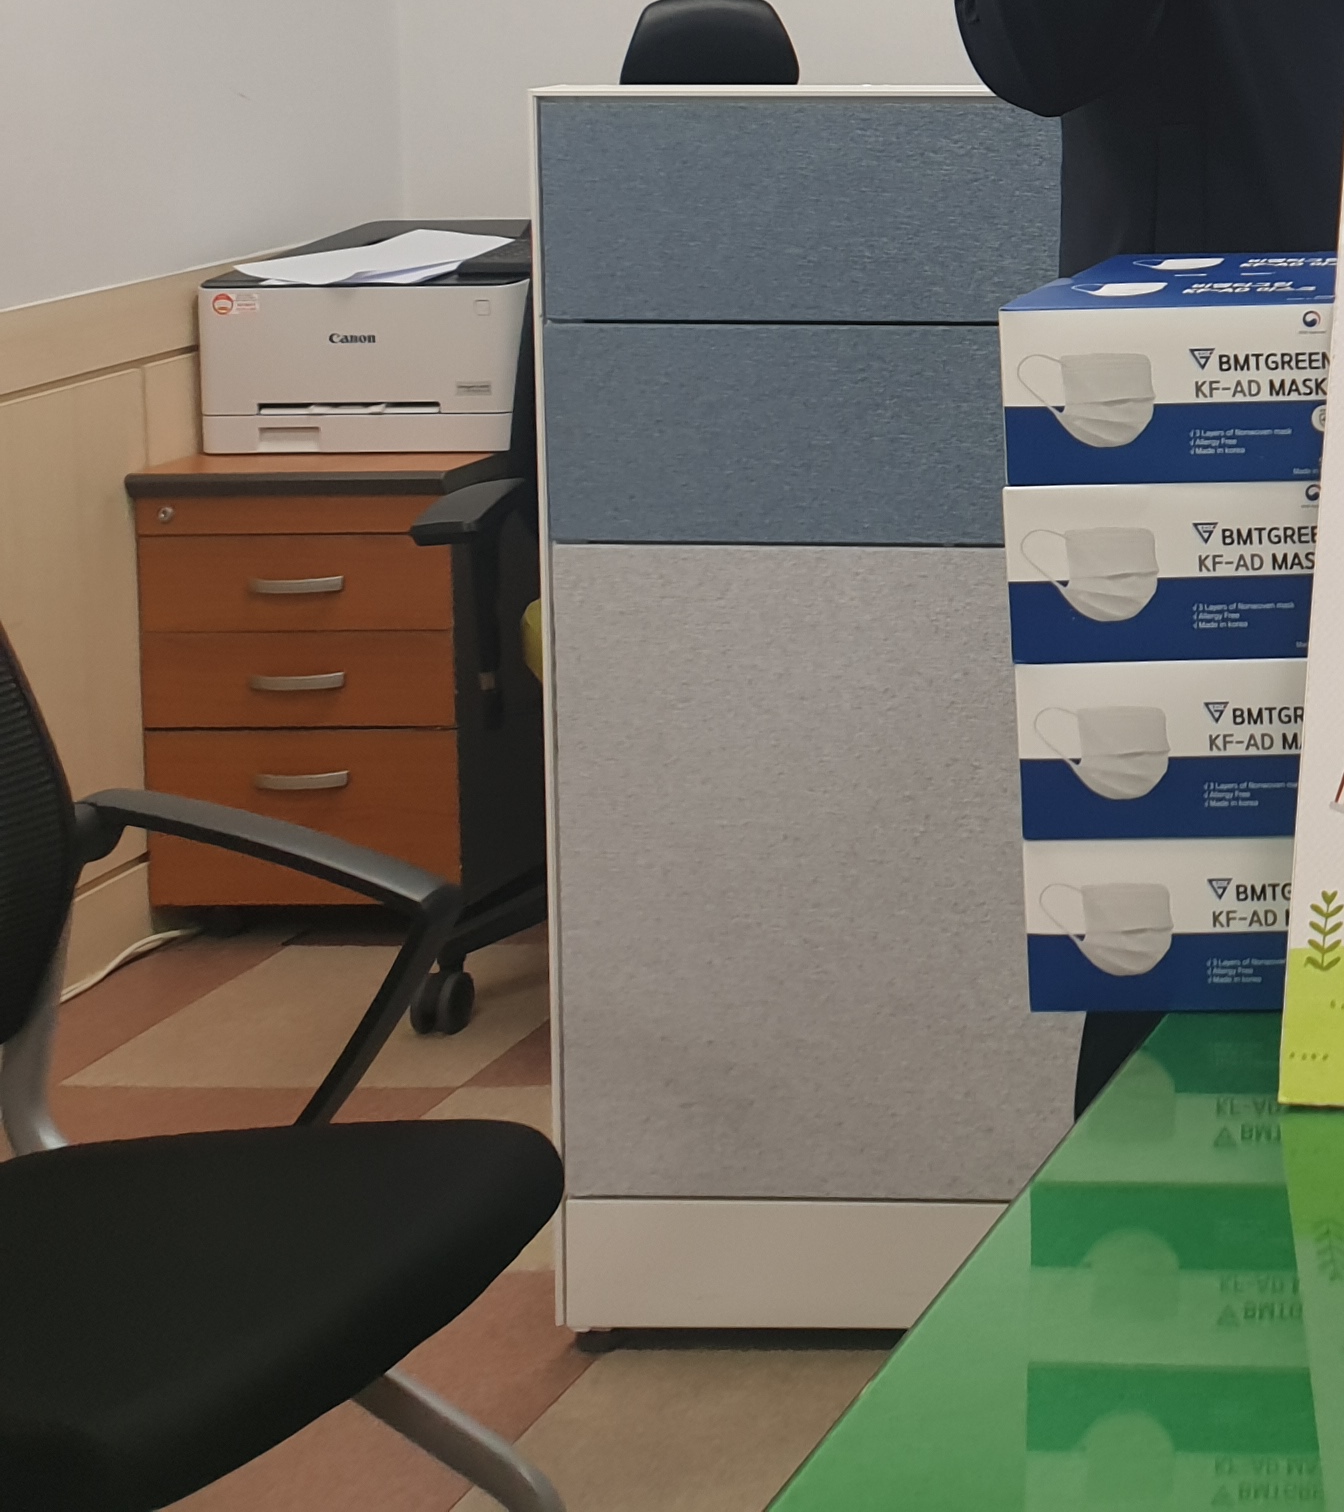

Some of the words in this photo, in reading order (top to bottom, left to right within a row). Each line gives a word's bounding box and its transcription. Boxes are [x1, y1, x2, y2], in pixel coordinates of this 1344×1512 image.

[328, 331, 377, 346] Canon
[1194, 380, 1262, 399] KF-AD
[1268, 378, 1328, 397] MASK
[1195, 438, 1220, 447] Allergy
[1221, 437, 1238, 445] Free
[1198, 553, 1264, 572] KF-AD
[1208, 733, 1275, 752] KF-AD
[1211, 908, 1277, 928] KF-AD
